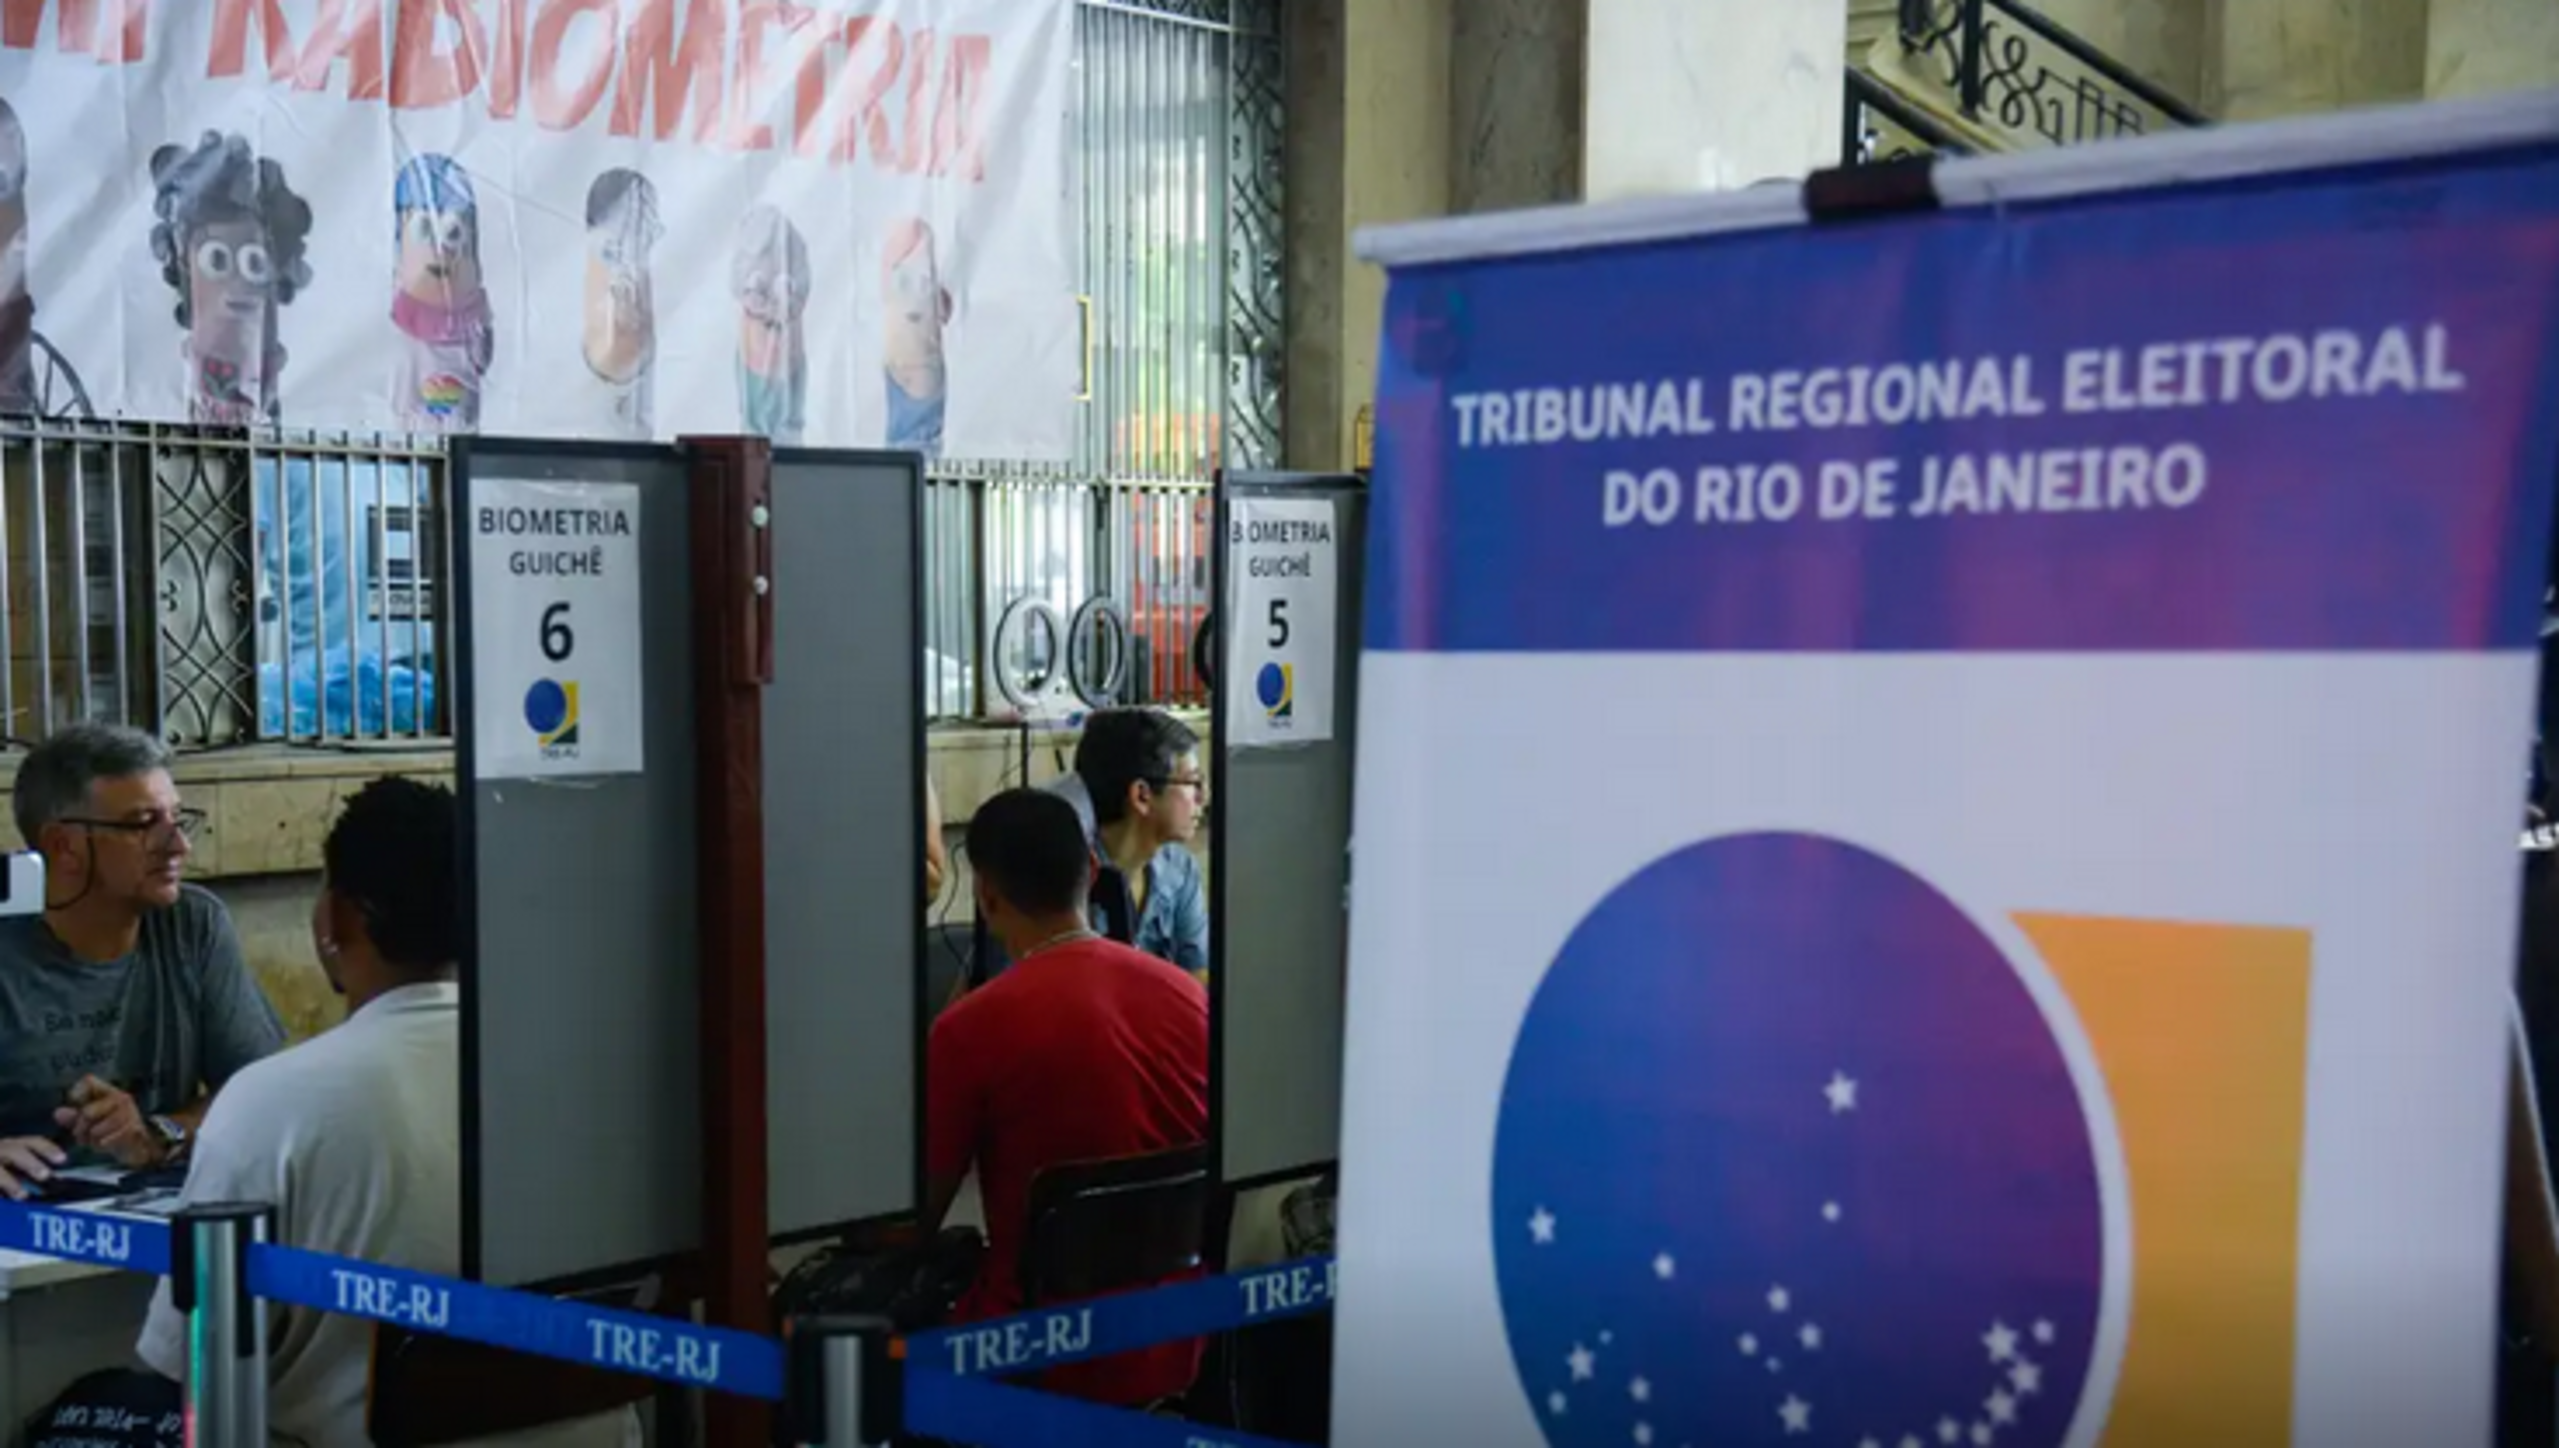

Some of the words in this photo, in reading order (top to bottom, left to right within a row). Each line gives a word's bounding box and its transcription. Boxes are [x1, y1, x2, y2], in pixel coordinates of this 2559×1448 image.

[1451, 377, 1715, 448] TRIBUNAL
[1728, 355, 2046, 432] REGIONAL
[2062, 322, 2466, 413] ELEITORAL
[1603, 467, 1681, 527] DO
[1695, 462, 1801, 523] RIO
[1817, 458, 1899, 519] DE
[1909, 442, 2207, 519] JANEIRO
[478, 506, 631, 537] BIOMETRIA
[1231, 520, 1331, 544] BOMETRIA
[508, 544, 604, 577] GUICHÊ
[1248, 552, 1312, 578] GUICHÊ
[540, 601, 574, 662] 6
[1267, 599, 1290, 649] 5
[28, 1211, 130, 1261] TRE-RJ
[331, 1269, 451, 1329] TRE-RJ
[586, 1318, 723, 1383] TRE-RJ
[945, 1309, 1093, 1376] TRE-RJ
